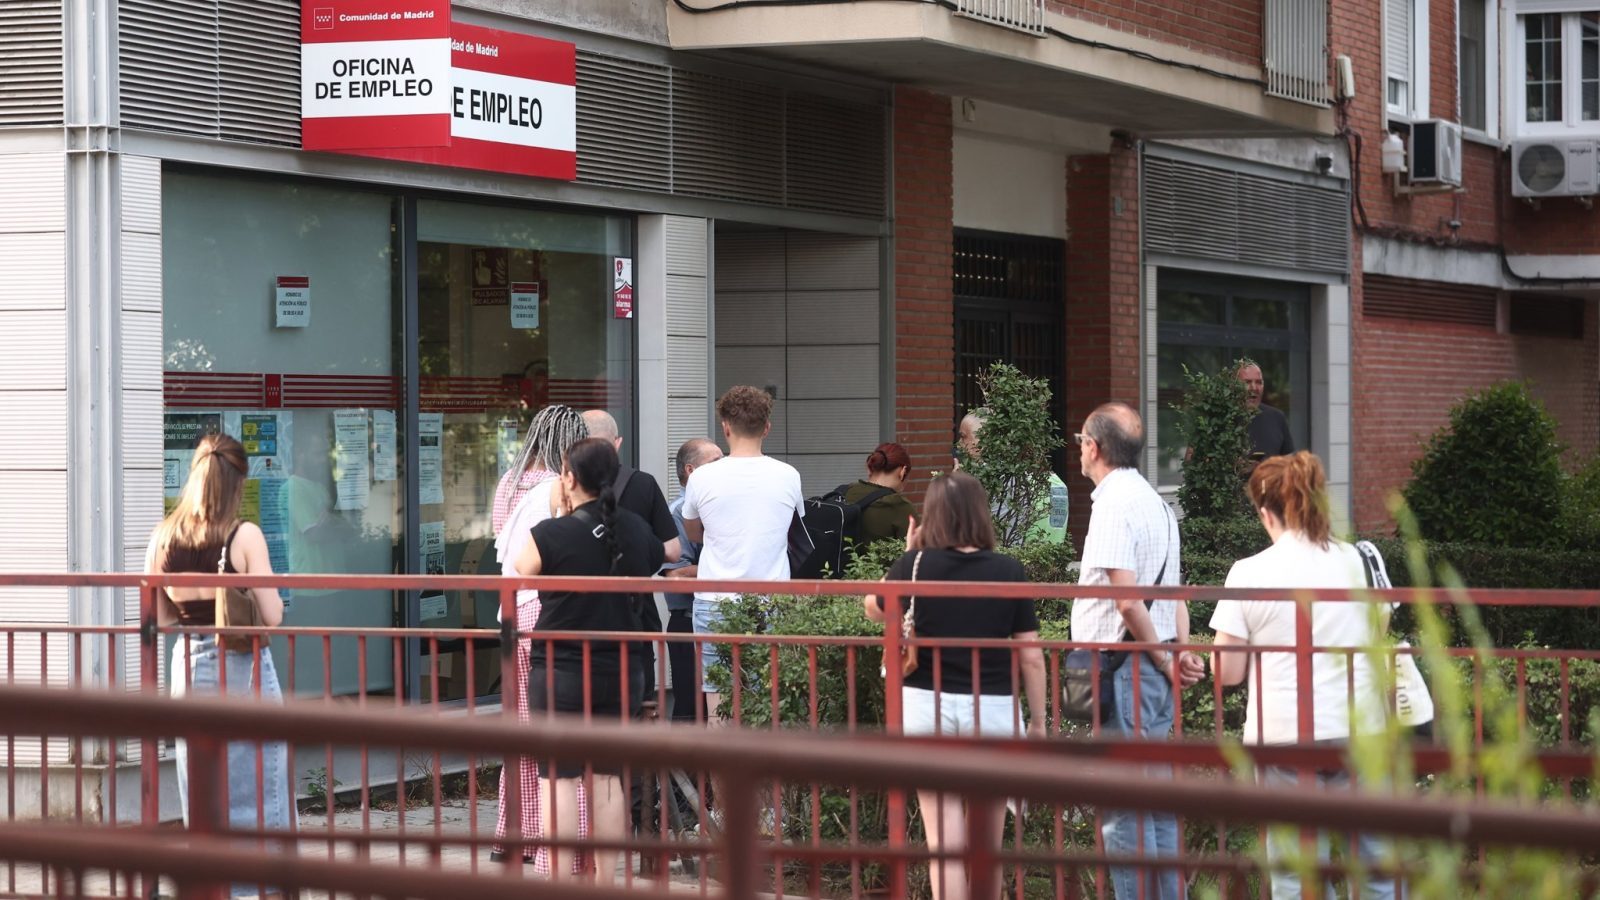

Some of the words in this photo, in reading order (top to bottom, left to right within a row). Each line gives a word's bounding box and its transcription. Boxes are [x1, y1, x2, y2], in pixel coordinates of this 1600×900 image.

[339, 13, 389, 22] Comunidad
[390, 12, 402, 20] de
[403, 11, 434, 19] Madrid
[465, 41, 475, 53] de
[475, 43, 498, 57] Madrid
[332, 57, 415, 77] OFICINA
[315, 82, 342, 99] DE
[348, 78, 433, 98] EMPLEO
[451, 86, 465, 119] E
[470, 88, 542, 129] EMPLEO
